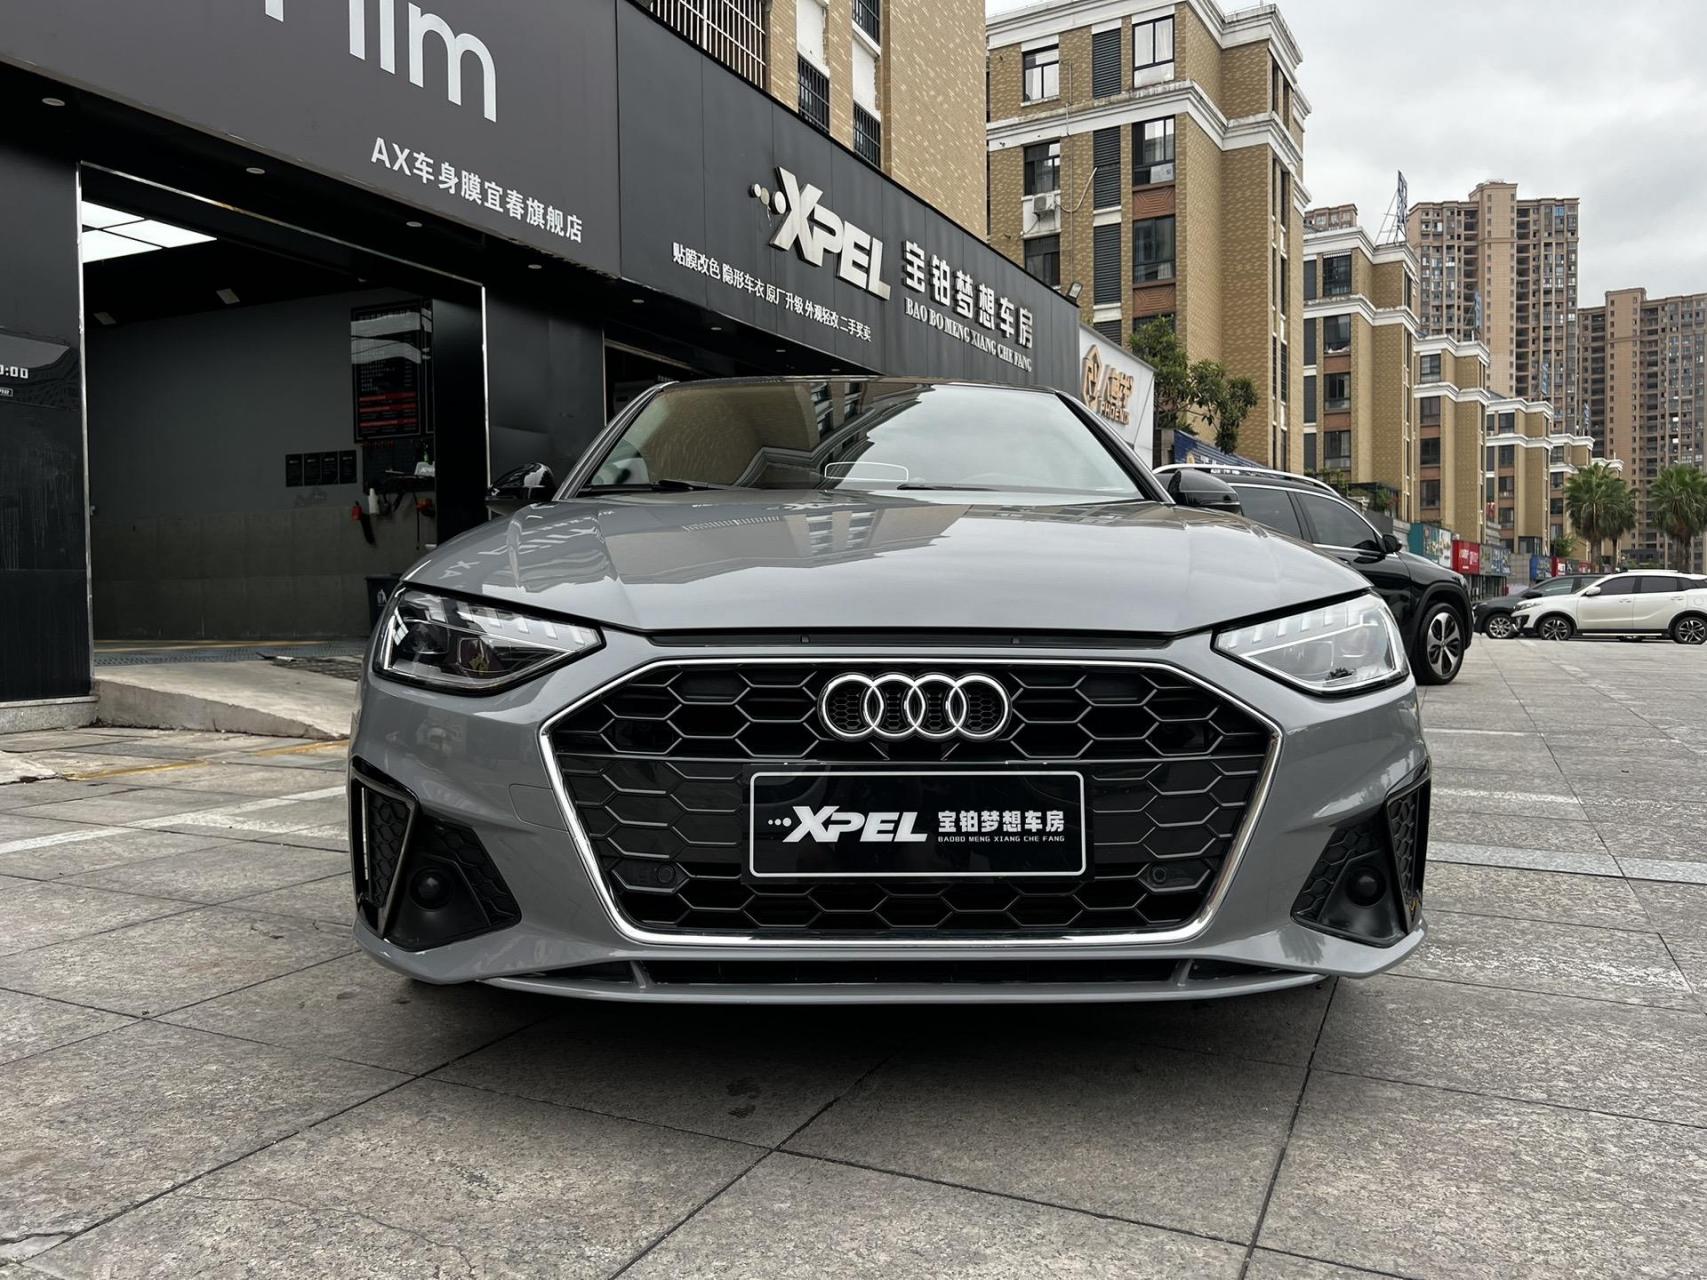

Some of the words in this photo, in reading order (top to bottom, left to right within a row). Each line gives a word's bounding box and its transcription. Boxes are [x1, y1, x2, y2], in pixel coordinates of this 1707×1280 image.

[371, 137, 582, 243] AX车身膜宜春旗舰店
[672, 241, 721, 280] 贴膜改色
[722, 263, 765, 299] 隐形车衣
[769, 166, 891, 300] XPEL
[905, 240, 1033, 349] 宝铂梦想车房
[905, 297, 928, 322] BAO
[929, 308, 944, 330] BO
[944, 317, 970, 343] MENG
[971, 329, 997, 355] XIANG
[997, 343, 1013, 364] CHE
[1013, 351, 1032, 372] FANG
[782, 805, 928, 842] XPEL
[938, 810, 1065, 832] 宝铂梦想车房
